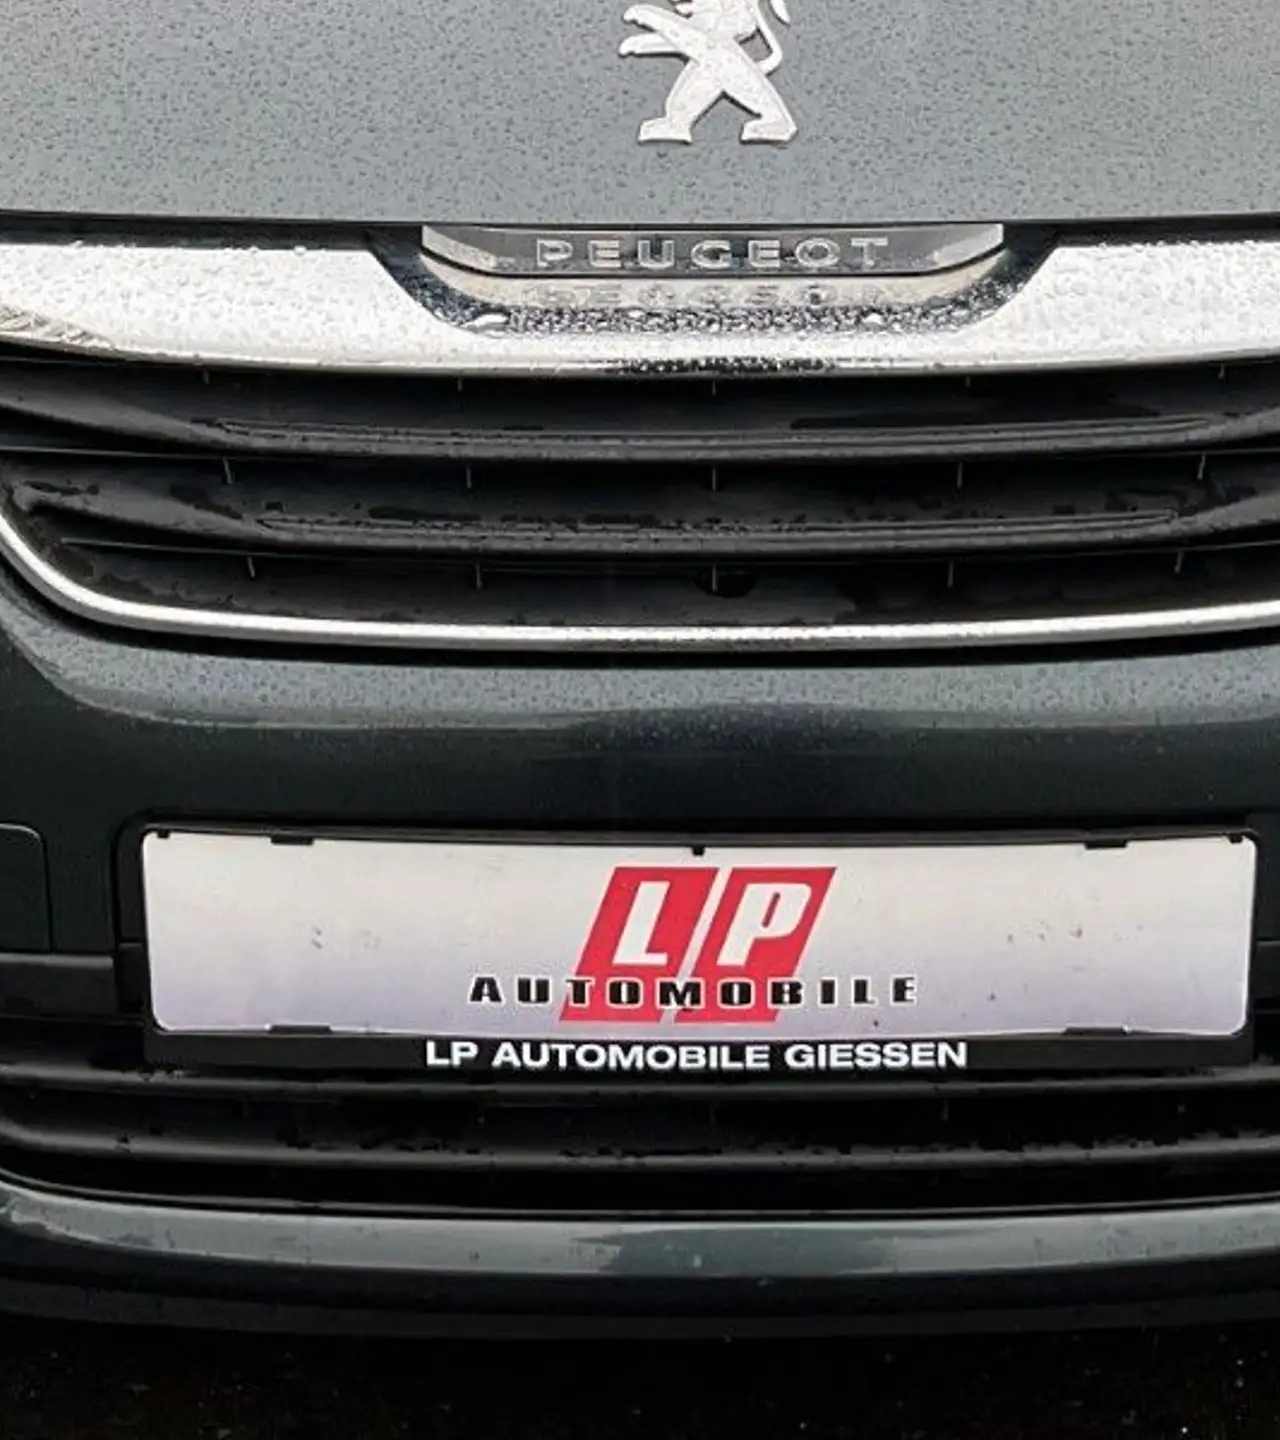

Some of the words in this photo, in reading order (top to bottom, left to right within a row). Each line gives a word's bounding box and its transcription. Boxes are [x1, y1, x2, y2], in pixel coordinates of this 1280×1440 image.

[535, 235, 889, 269] PEUGEOT
[612, 880, 813, 967] LP
[469, 975, 917, 1007] AUTOMOBILE
[426, 1040, 478, 1069] LP
[491, 1041, 770, 1071] AUTOMOBILE
[783, 1040, 968, 1070] GIESSEN
